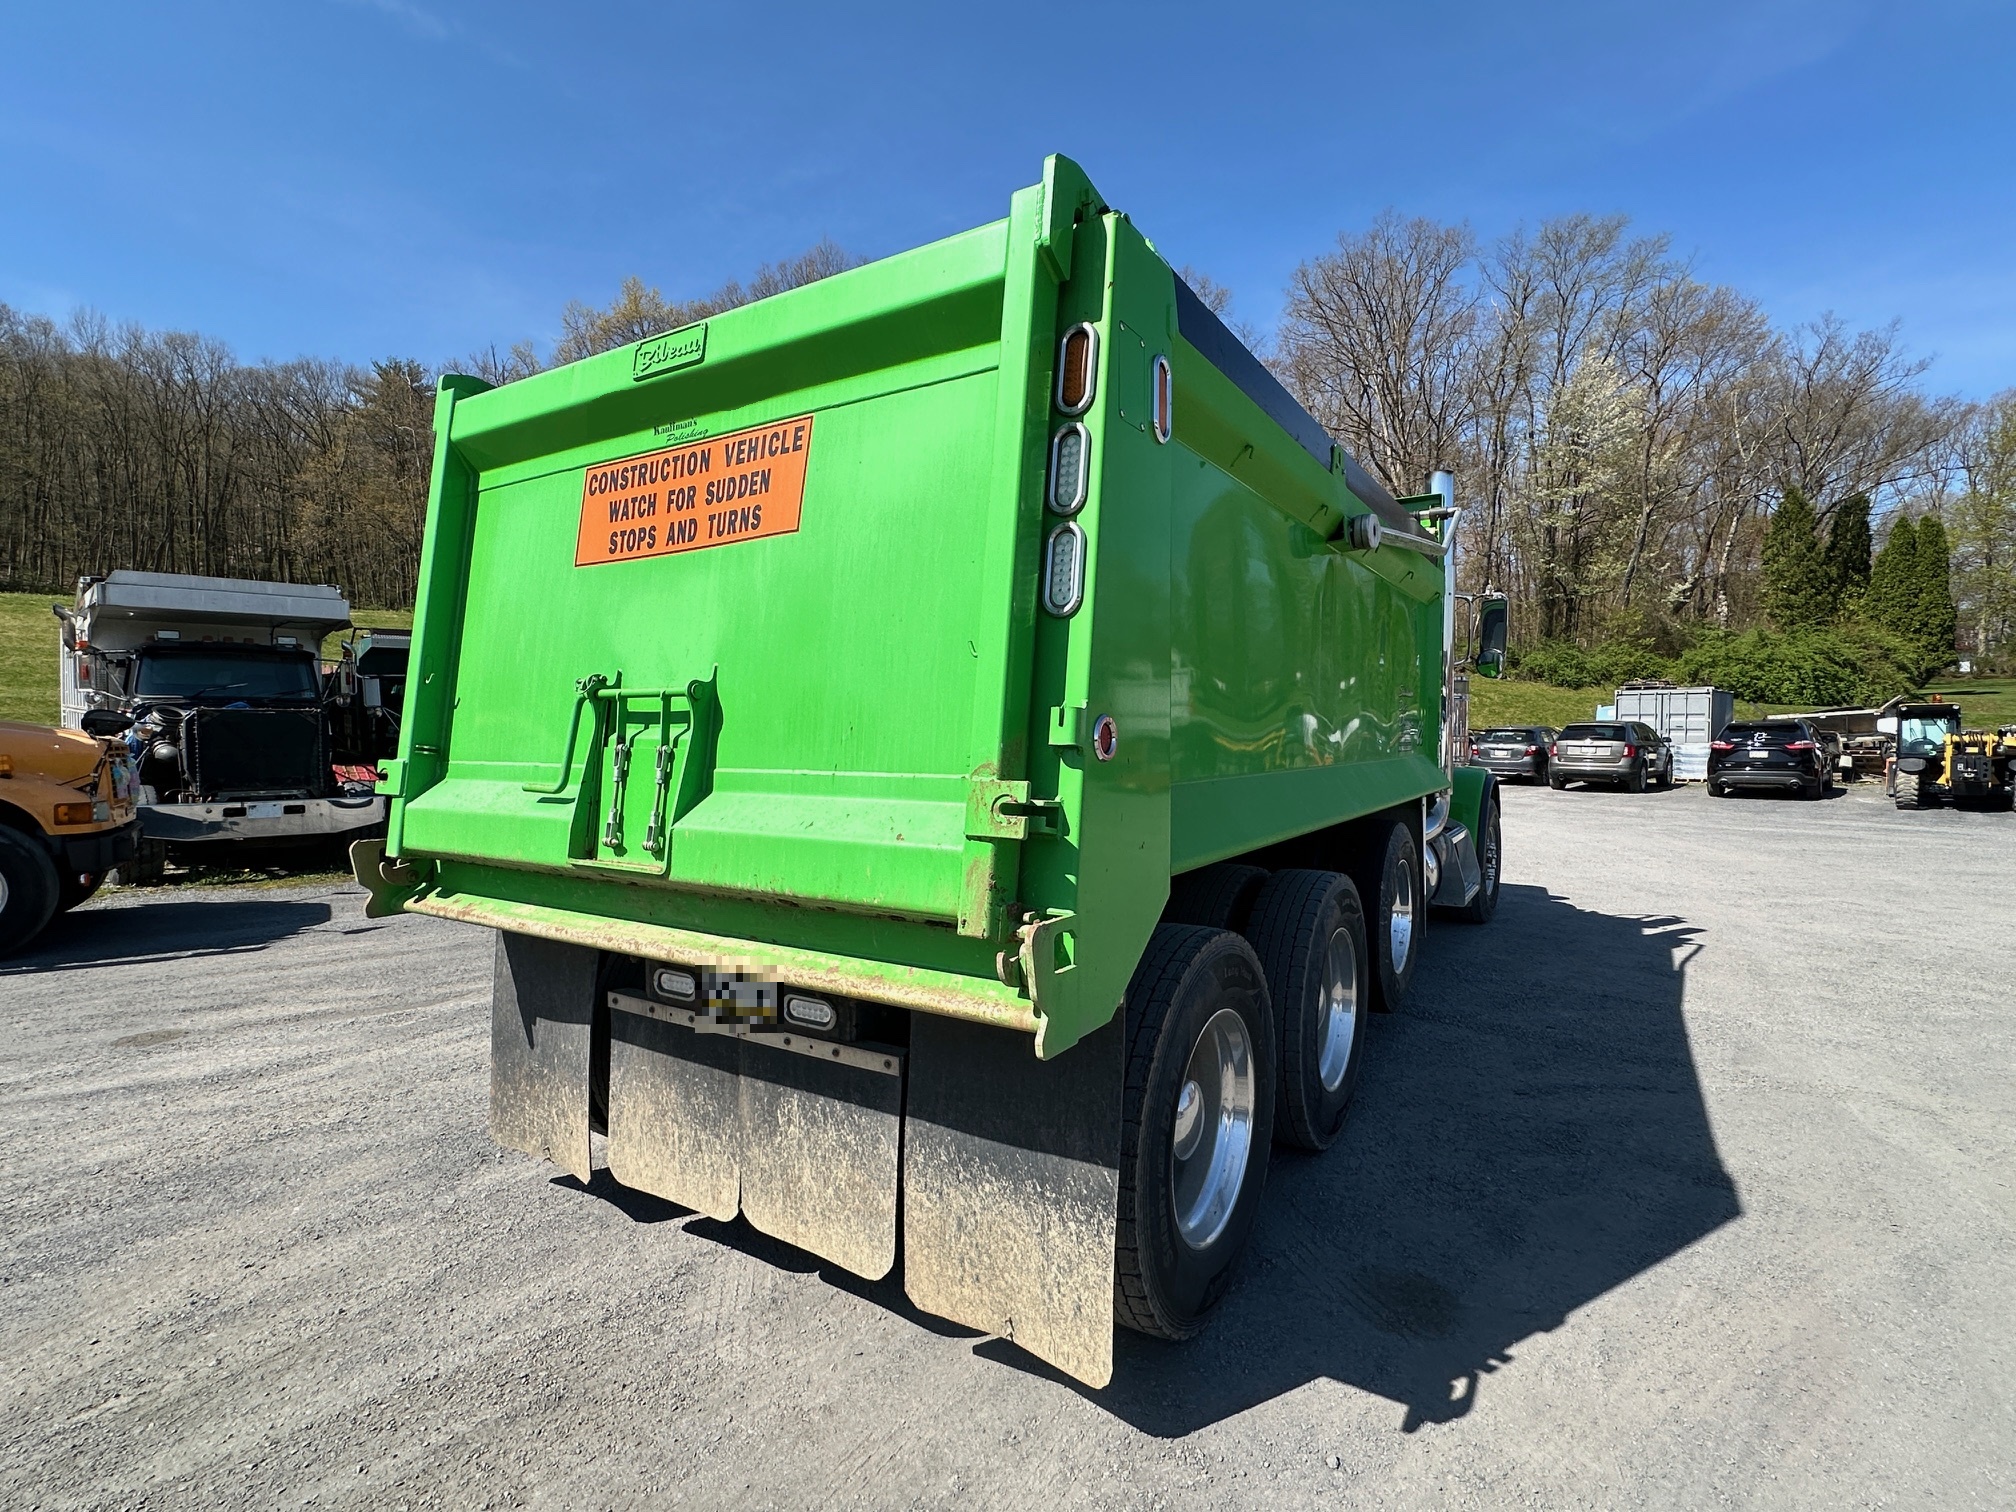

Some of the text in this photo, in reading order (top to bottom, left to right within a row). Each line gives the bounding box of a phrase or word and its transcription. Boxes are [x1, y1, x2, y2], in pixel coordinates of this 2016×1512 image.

[588, 425, 806, 497] CONSTRUCTION VEHICLE
[665, 428, 709, 444] Polishing
[609, 468, 772, 523] WATCH FOR SUDDEN
[608, 504, 762, 555] STOPS AND TURNS
